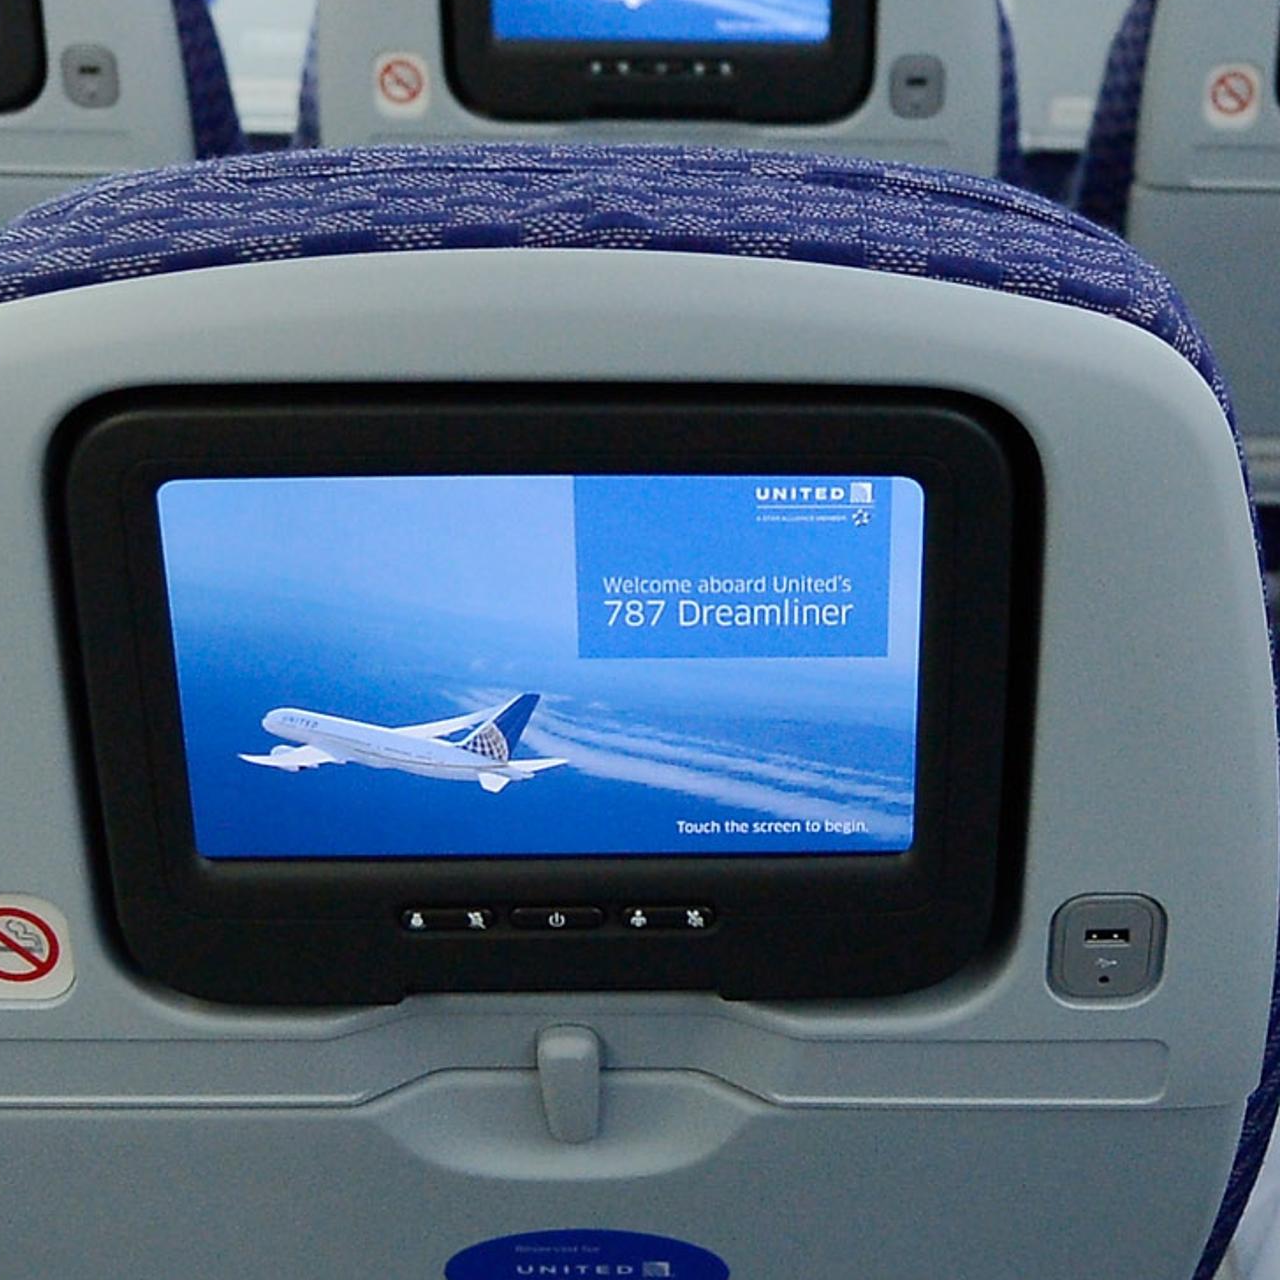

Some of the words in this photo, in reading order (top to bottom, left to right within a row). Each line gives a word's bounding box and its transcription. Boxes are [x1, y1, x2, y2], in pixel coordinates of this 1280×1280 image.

[755, 485, 846, 501] UNITED
[603, 576, 692, 594] Welcome
[698, 575, 767, 594] aboard
[772, 575, 852, 594] United's
[603, 599, 665, 627] 787
[678, 597, 854, 627] Dreamliner
[677, 820, 720, 834] Touch
[724, 820, 749, 834] the
[752, 821, 802, 834] screen
[805, 821, 820, 834] to
[824, 820, 870, 835] begin.
[516, 1264, 634, 1275] UNITED
